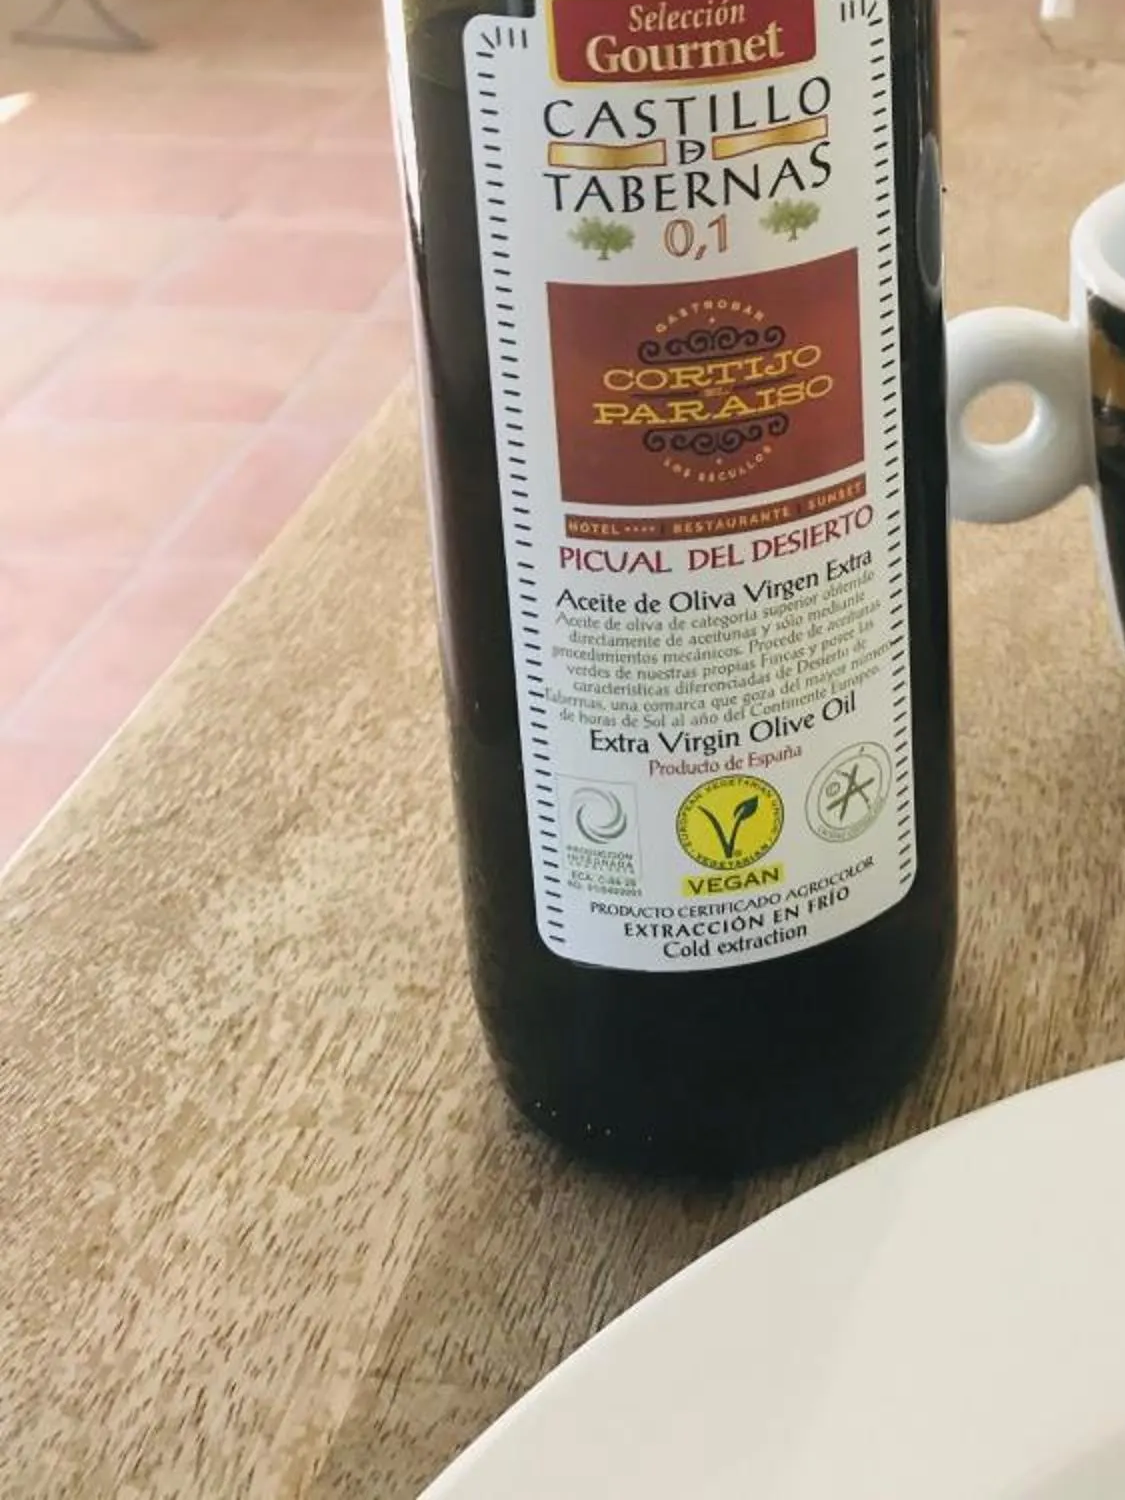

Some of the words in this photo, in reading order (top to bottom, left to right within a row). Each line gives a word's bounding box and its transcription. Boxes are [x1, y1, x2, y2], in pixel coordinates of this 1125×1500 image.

[585, 20, 785, 75] Gourmet
[543, 76, 831, 139] CASTILLO
[542, 141, 832, 215] TABERNAS
[663, 213, 729, 261] 0,1
[602, 344, 822, 392] CORTIJO
[593, 375, 834, 425] PARAISO
[567, 521, 621, 536] HOTEL
[672, 505, 792, 534] RESTAURANTE
[807, 481, 865, 511] SUNSET
[559, 545, 672, 574] PICUAL
[688, 543, 745, 571] DEL
[751, 504, 874, 563] DESIERTO
[555, 587, 627, 614] Aceite
[634, 592, 661, 614] de
[668, 589, 736, 613] Oliva
[743, 571, 820, 602] Virgen
[825, 550, 873, 582] Extra
[555, 611, 600, 629] Aceite
[604, 615, 622, 631] de
[626, 617, 664, 632] oliva
[668, 615, 686, 631] de
[762, 591, 818, 619] superior
[569, 630, 662, 649] directamente
[665, 632, 684, 648] de
[688, 626, 757, 645] aceitunas
[615, 666, 631, 680] de
[591, 728, 649, 754] Extra
[658, 728, 740, 757] Virgin
[749, 715, 816, 745] Olive
[822, 689, 856, 722] Oil
[611, 699, 638, 712] una
[648, 756, 720, 777] Producto
[724, 755, 744, 773] de
[747, 744, 803, 771] España
[590, 901, 674, 919] PRODUCTO
[677, 892, 782, 919] CERTIFICADO
[784, 855, 876, 900] AGROCOLOR
[687, 867, 780, 896] VEGAN
[623, 914, 765, 939] EXTRACCIÓN
[773, 905, 800, 924] EN
[807, 886, 851, 914] FRÍO
[663, 939, 711, 959] Cold
[717, 924, 808, 956] extraction
